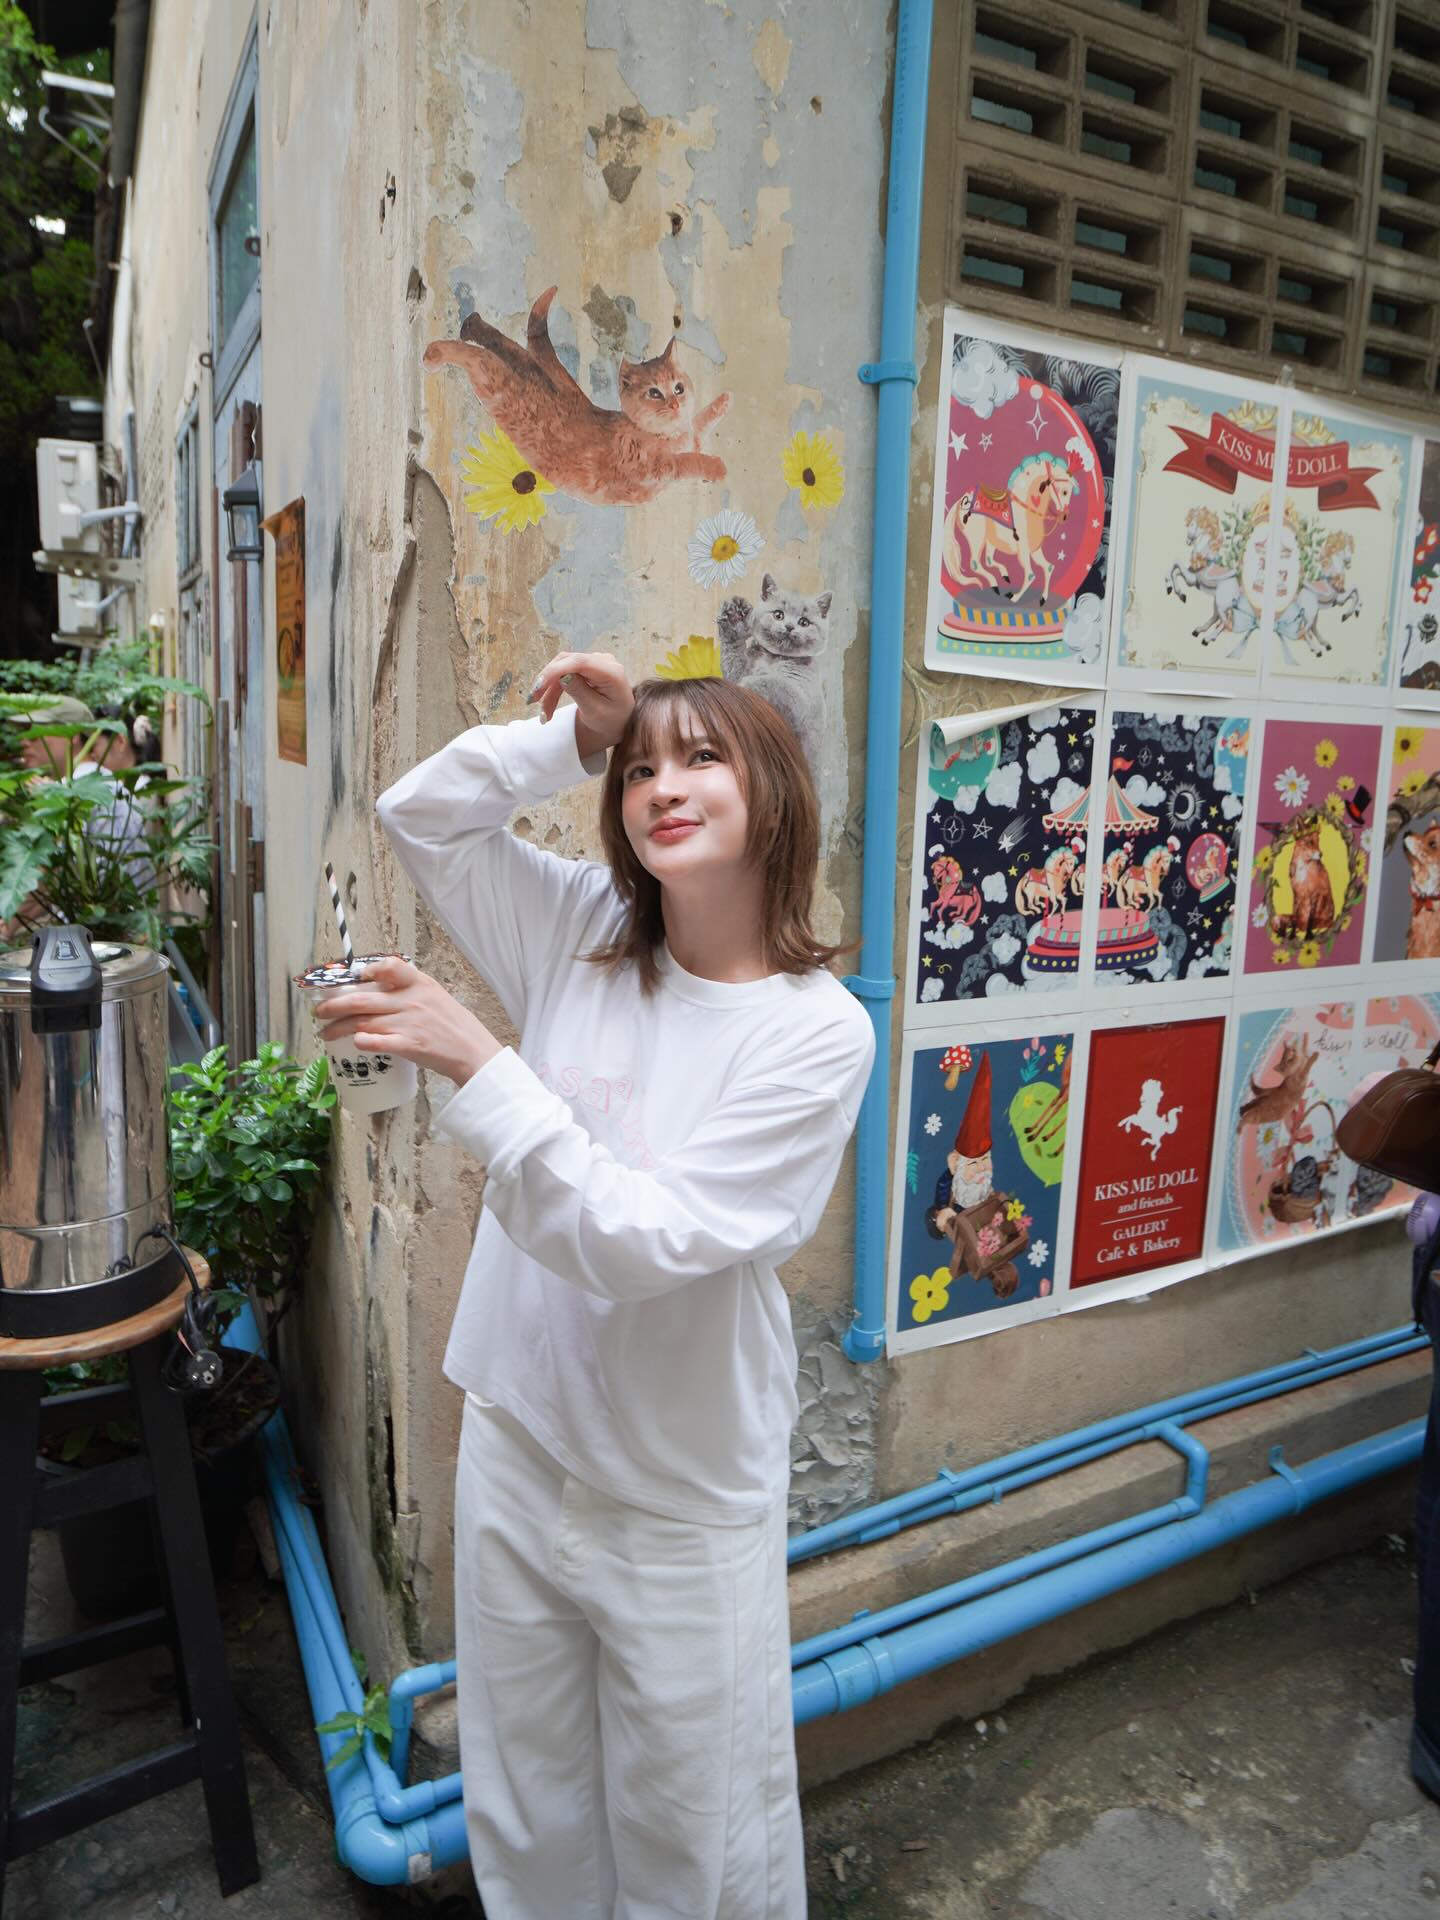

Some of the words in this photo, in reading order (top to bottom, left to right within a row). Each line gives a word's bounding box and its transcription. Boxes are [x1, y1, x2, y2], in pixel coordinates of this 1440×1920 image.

[1217, 429, 1253, 463] KISS
[1297, 454, 1342, 476] DOLL
[1094, 1180, 1129, 1202] KISS
[1130, 1175, 1156, 1194] ME
[1158, 1167, 1199, 1189] DOLL
[1117, 1199, 1138, 1214] and
[1138, 1192, 1174, 1210] friends
[1112, 1218, 1169, 1241] GALLERY
[1096, 1246, 1125, 1263] Cafe
[1127, 1243, 1139, 1257] &
[1142, 1237, 1182, 1254] Bakery
